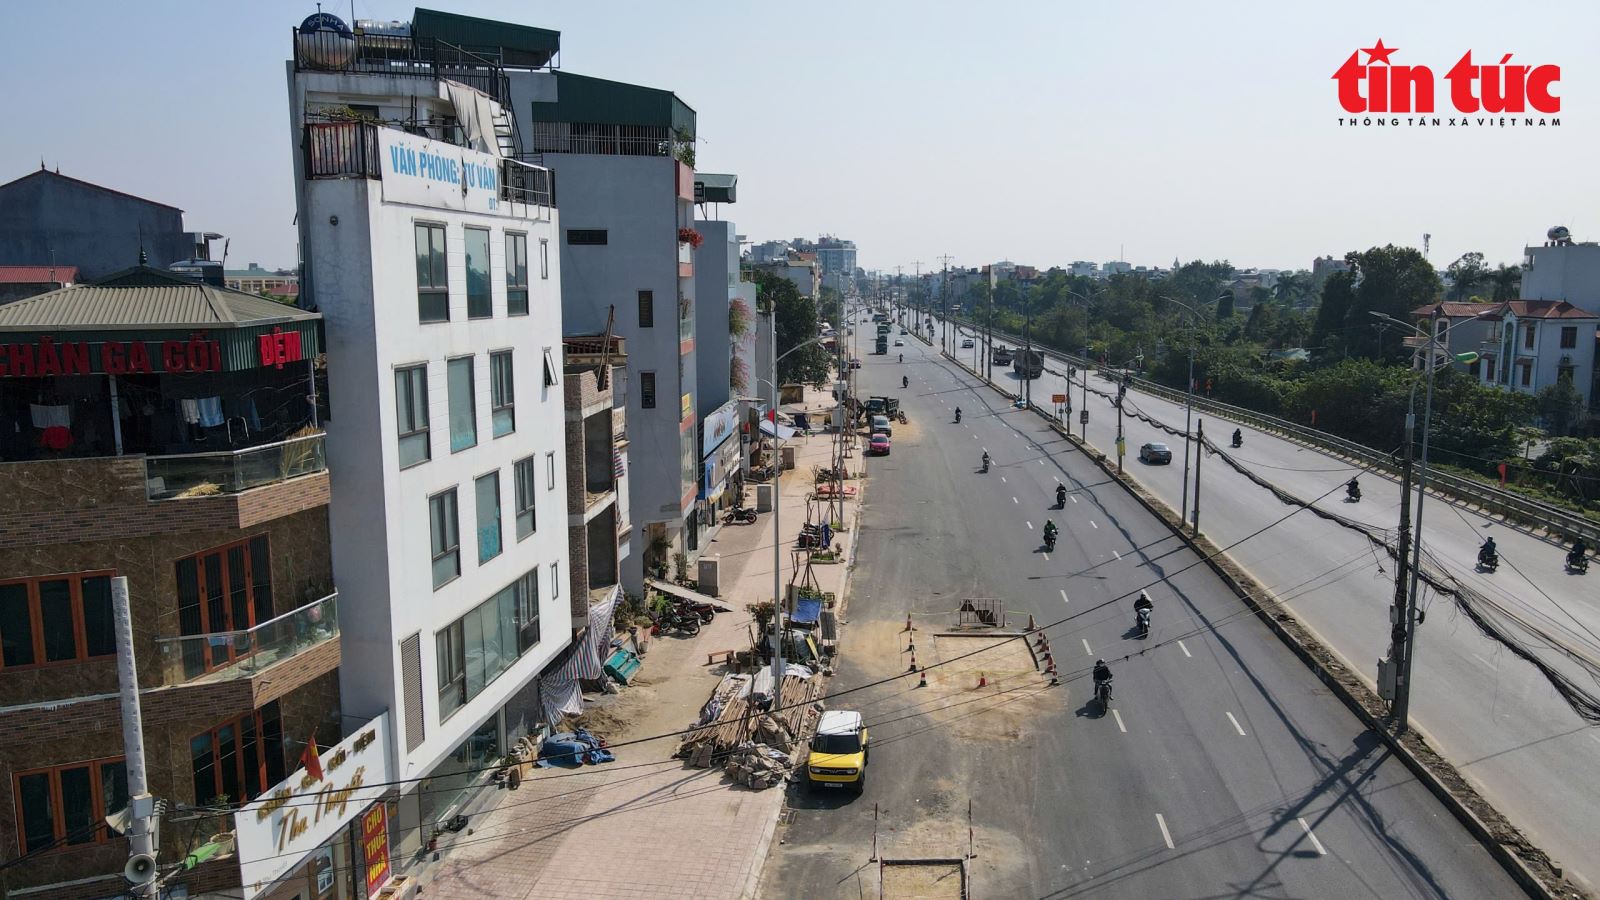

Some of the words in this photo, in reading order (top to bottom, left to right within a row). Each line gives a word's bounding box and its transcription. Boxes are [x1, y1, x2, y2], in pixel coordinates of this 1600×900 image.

[390, 142, 417, 177] VĂN
[101, 340, 153, 375] GA
[259, 326, 302, 369] ĐỆM
[366, 806, 382, 834] CHO
[366, 826, 386, 859] THUÊ
[369, 852, 387, 883] NHÀ
